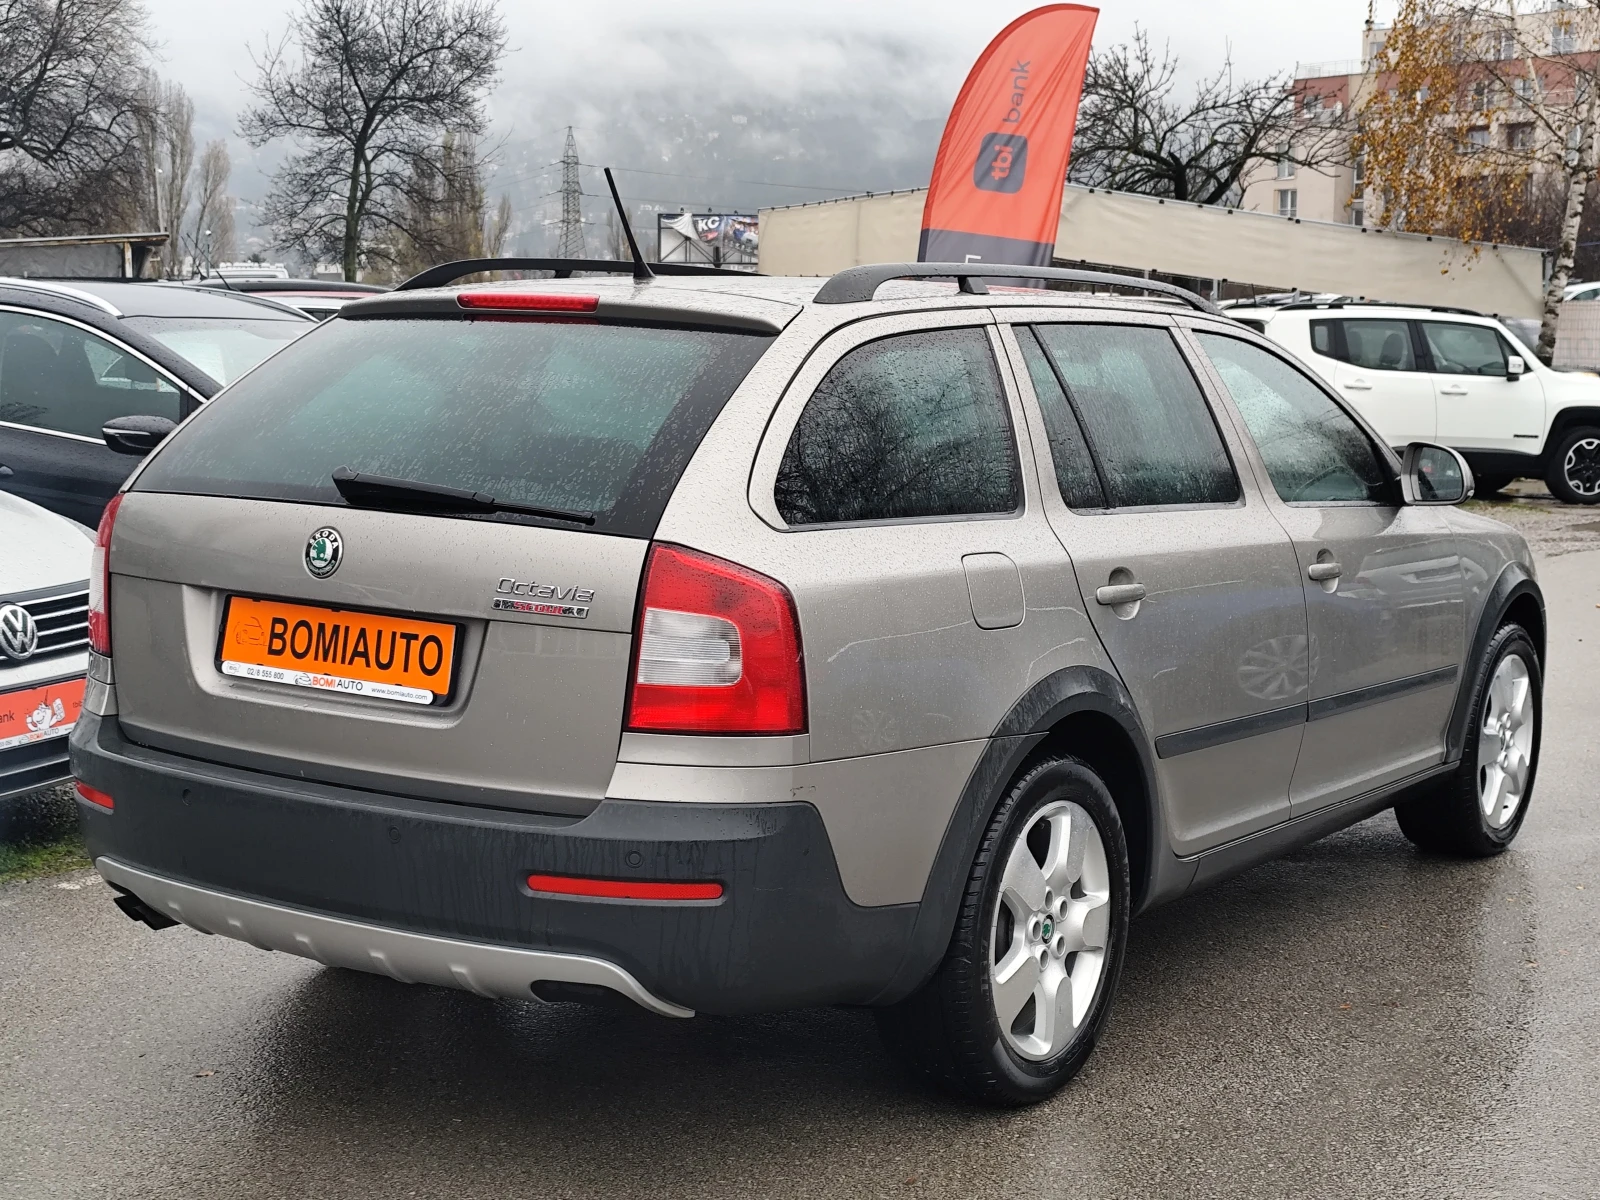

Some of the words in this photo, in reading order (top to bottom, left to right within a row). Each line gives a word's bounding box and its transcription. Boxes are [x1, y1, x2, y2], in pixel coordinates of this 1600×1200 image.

[1002, 59, 1031, 123] bank
[991, 144, 1013, 181] tbi
[496, 577, 595, 603] Octavia
[267, 617, 444, 677] BOMIAUTO
[371, 687, 428, 701] www.bomiauto.com
